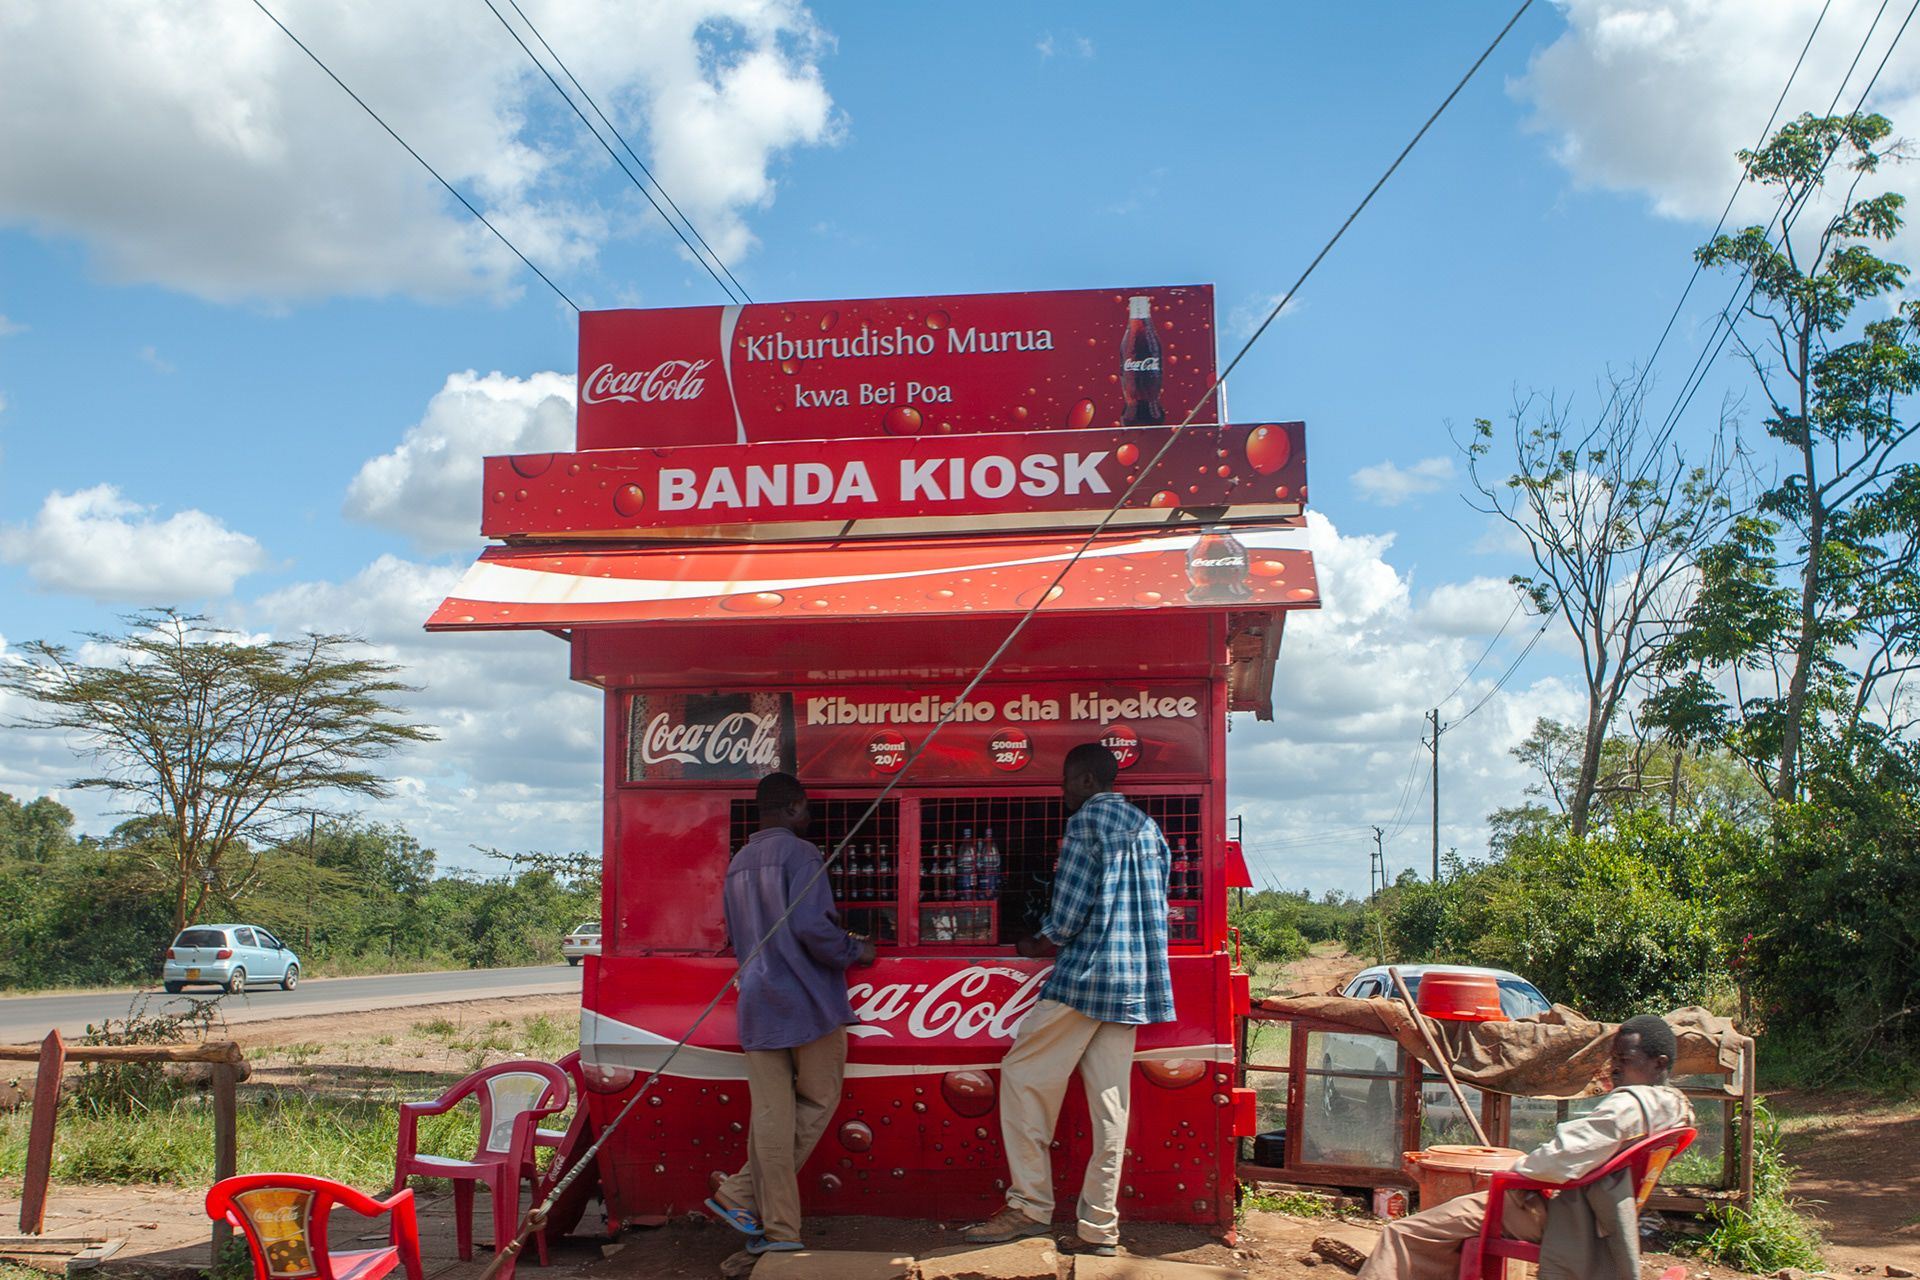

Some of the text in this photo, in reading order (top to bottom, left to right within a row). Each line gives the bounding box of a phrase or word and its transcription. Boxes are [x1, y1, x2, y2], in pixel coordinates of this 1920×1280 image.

[747, 327, 1055, 362] Kiburudisho Murua
[582, 359, 714, 404] Coca-Cola
[795, 382, 953, 408] kwa Bei Poa
[658, 451, 1111, 511] BANDA KIOSK
[807, 691, 1198, 726] Kiburudisho cha kipekee
[870, 742, 906, 753] 300ml
[991, 740, 1028, 750] 500ml
[1109, 737, 1138, 747] Litre
[874, 753, 903, 767] 20/-
[995, 751, 1025, 765] 28/-
[1111, 749, 1133, 763] 0/-
[846, 964, 1055, 1040] ca-Col
[253, 1204, 300, 1222] Coca-Cola
